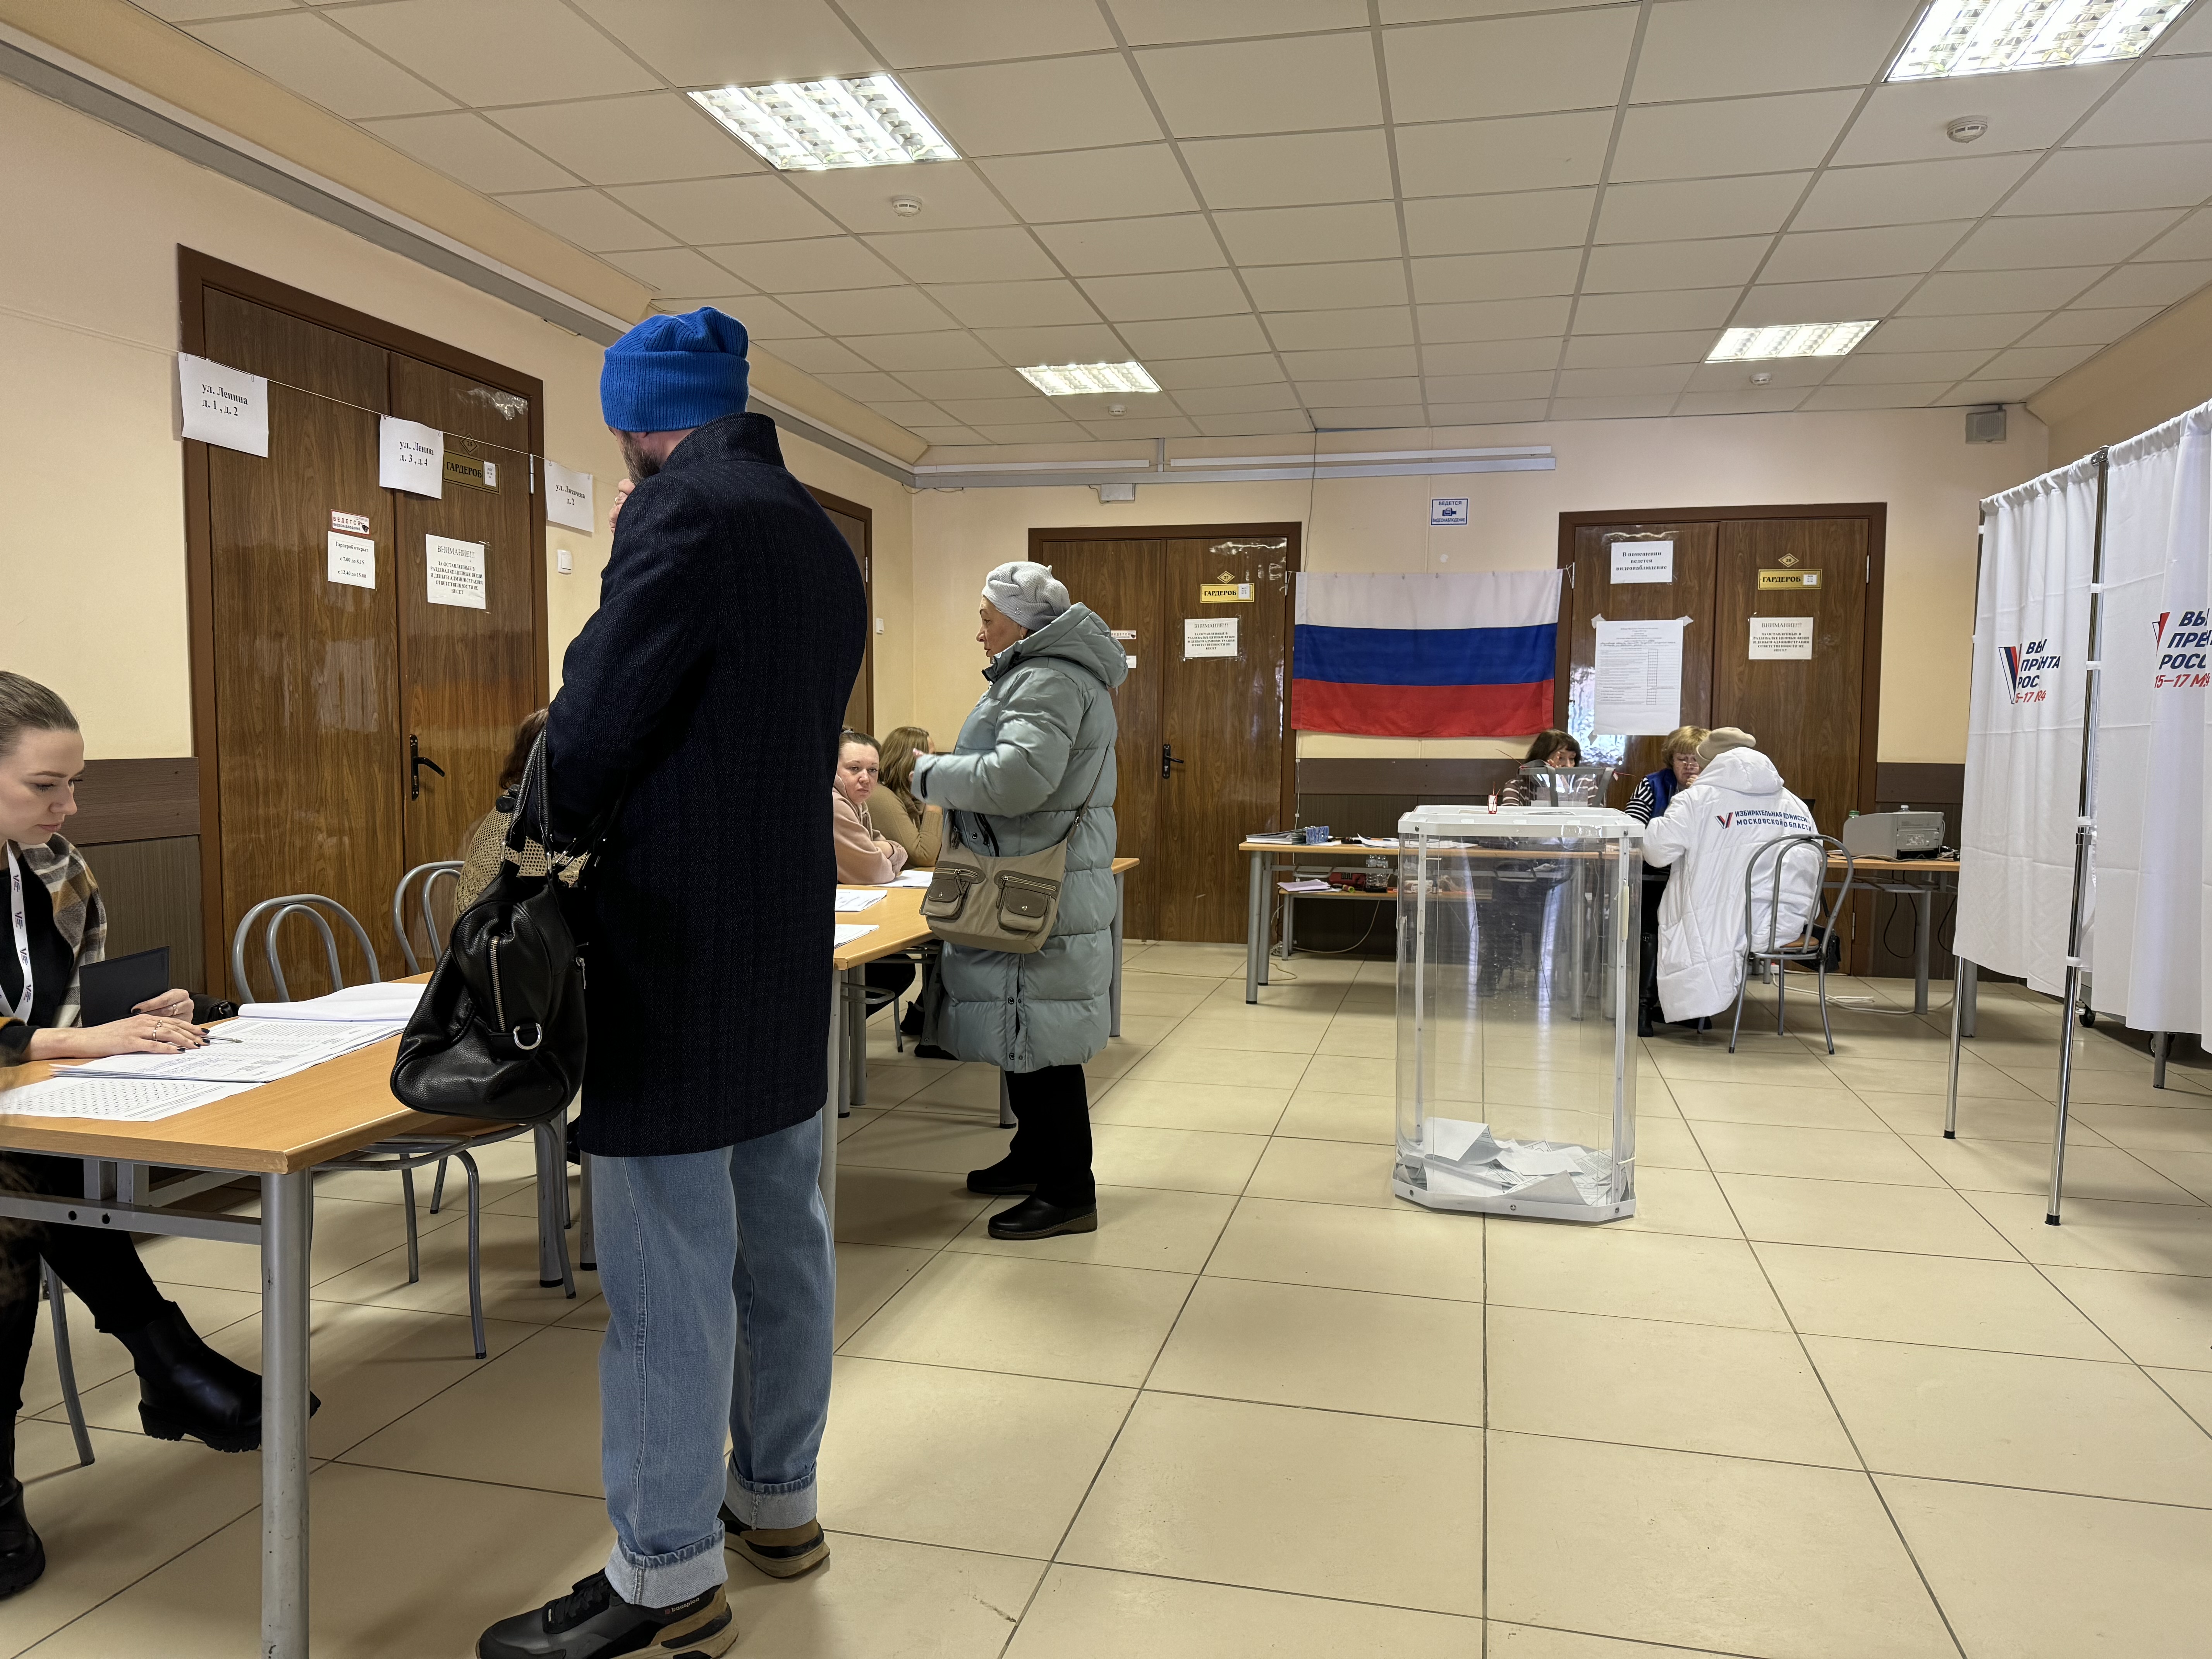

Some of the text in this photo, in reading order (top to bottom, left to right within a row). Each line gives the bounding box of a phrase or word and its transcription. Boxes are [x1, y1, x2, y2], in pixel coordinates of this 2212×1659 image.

[202, 384, 248, 405] ул. Ленина
[202, 400, 210, 408] д.
[234, 407, 238, 416] 2
[400, 441, 434, 455] ул. Ленина
[409, 454, 412, 462] 3
[447, 462, 482, 478] ГАРДЕРОБ
[333, 517, 361, 526] ВЕДЕТСЯ
[438, 545, 475, 558] ВНИМАНИЕ!!!
[430, 566, 455, 574] РАЗДЕВАЛКЕ
[443, 562, 472, 570] ОСТАВЛЕННЫЕ
[435, 580, 473, 589] ОТВЕТСТВЕННОСТИ
[450, 576, 483, 585] АДМИНИСТРАЦИЯ
[1783, 812, 1810, 823] КОМИССИ
[1736, 818, 1812, 832] МОСКОВСКОЙ ОБЛАСТИ
[672, 1597, 700, 1612] baasploa
